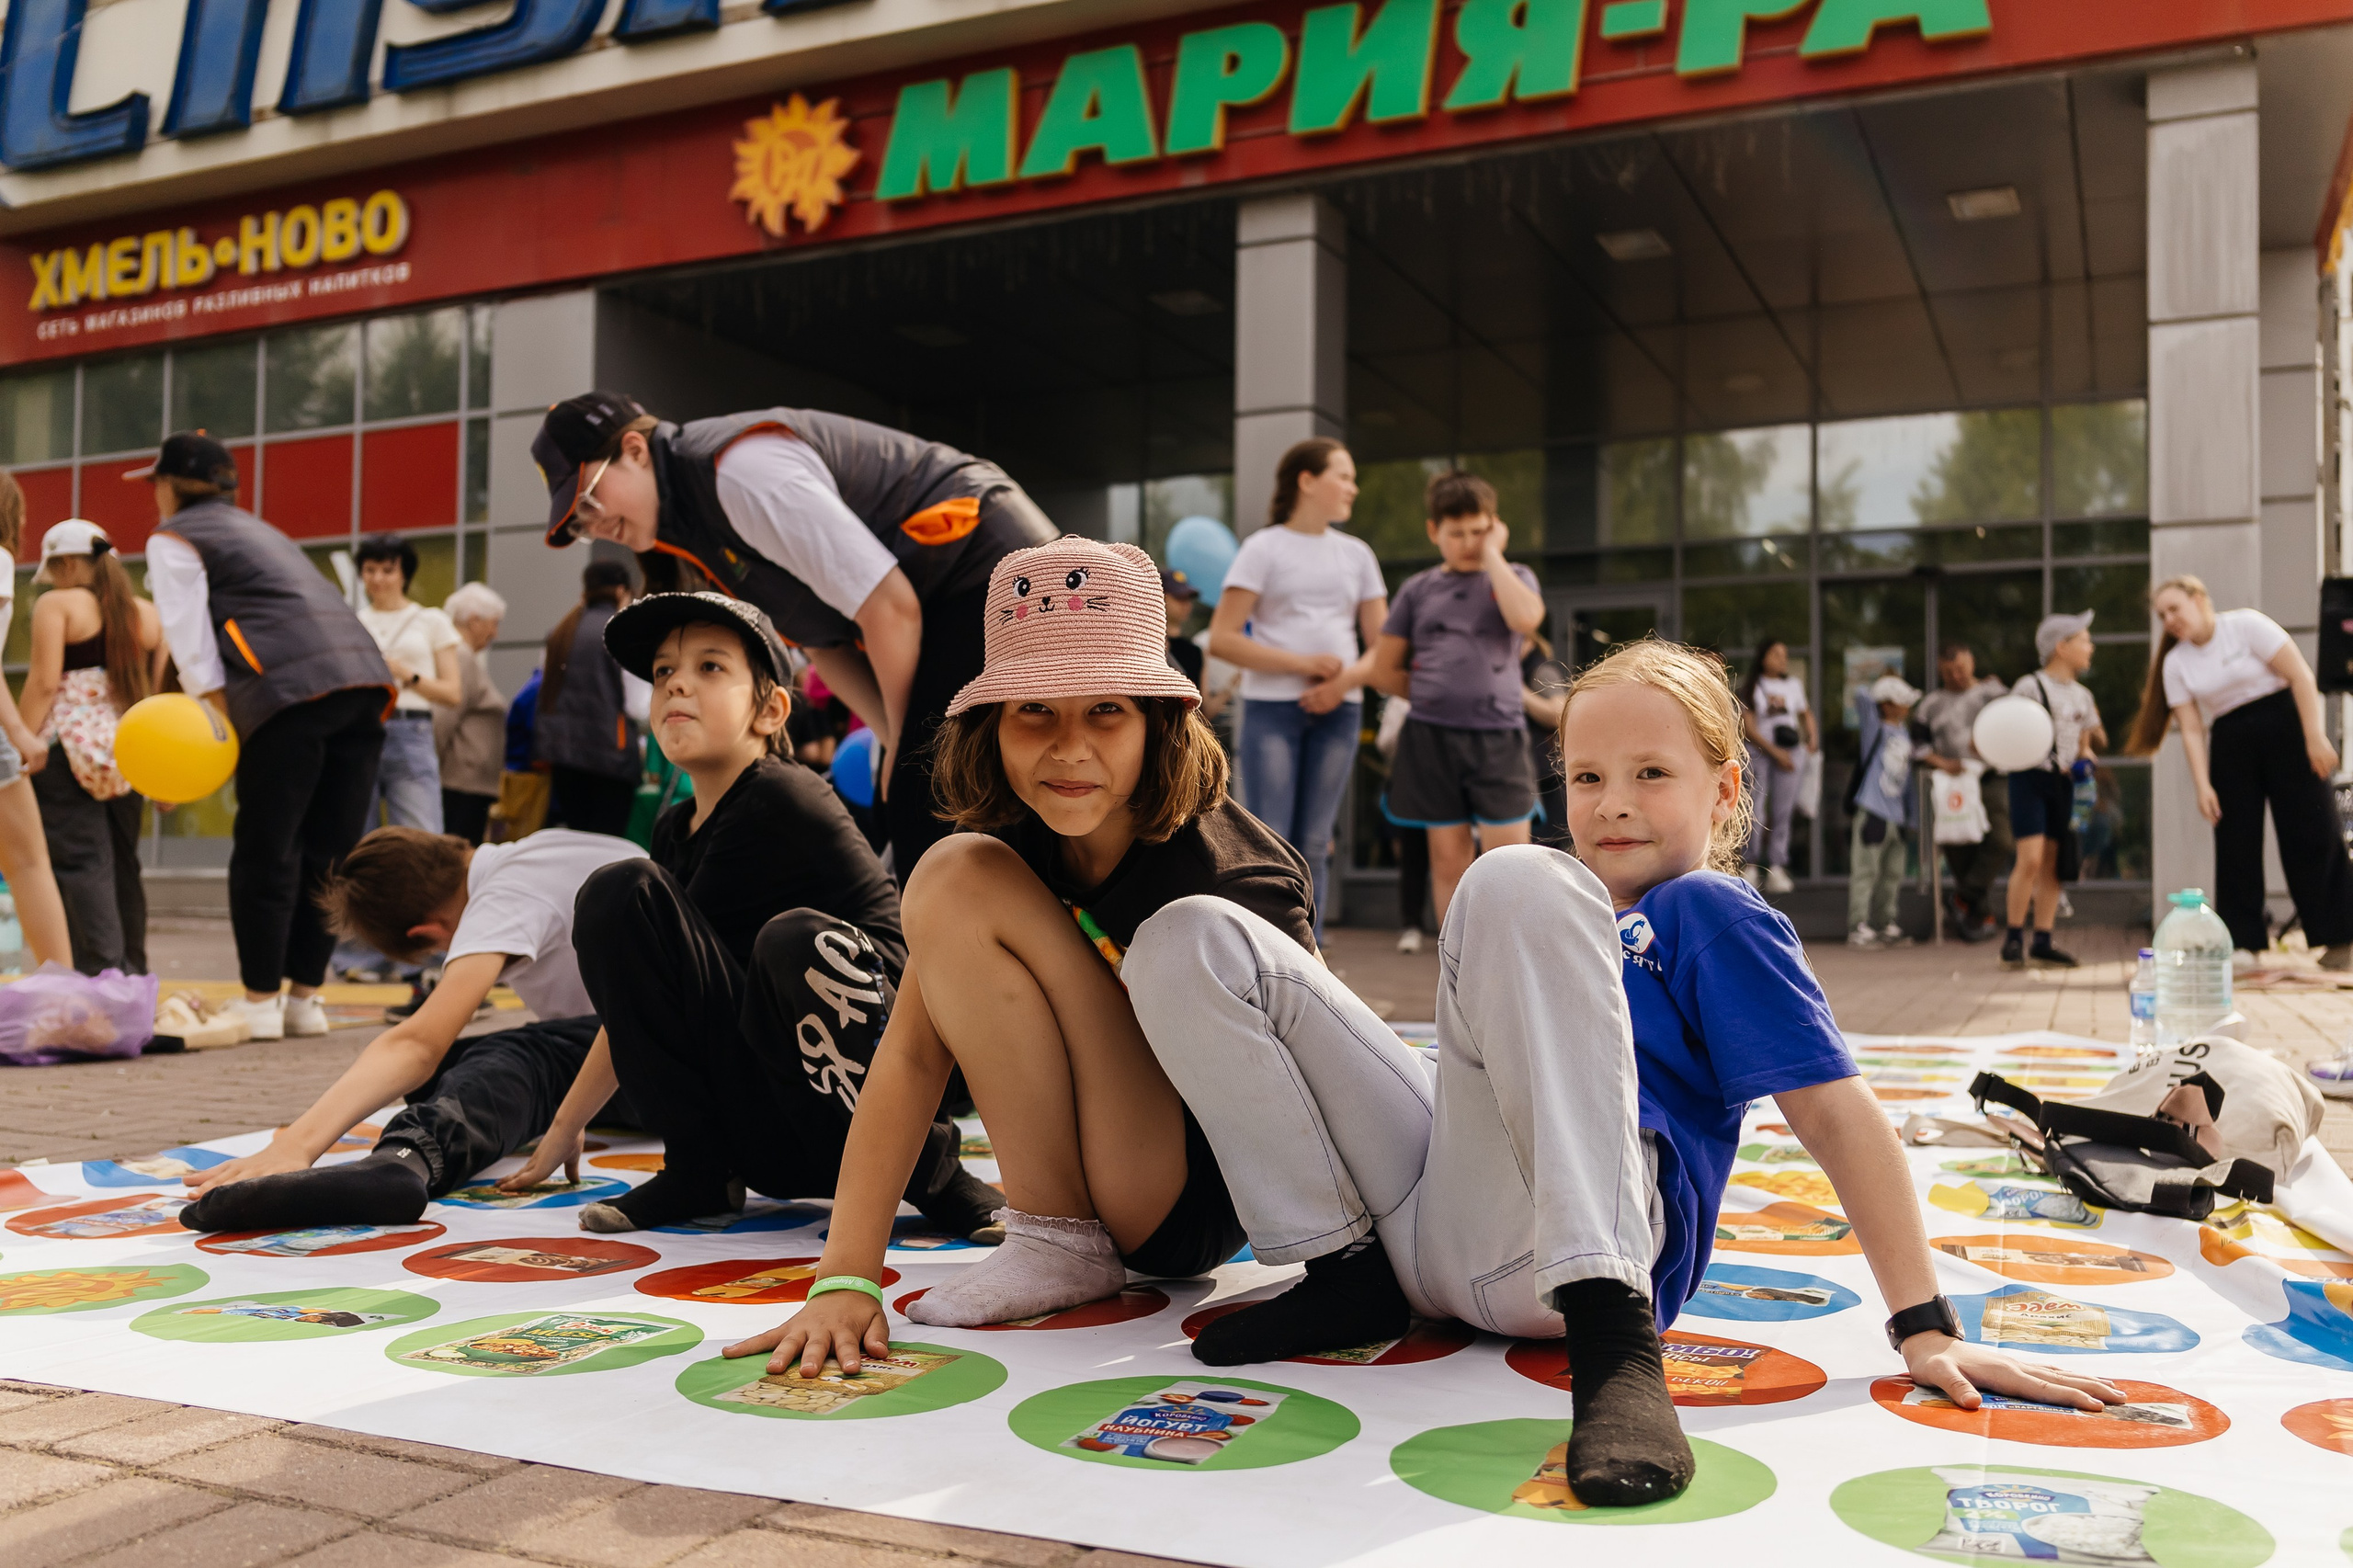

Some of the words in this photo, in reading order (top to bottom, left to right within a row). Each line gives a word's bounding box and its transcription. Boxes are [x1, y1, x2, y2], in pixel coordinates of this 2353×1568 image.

[37, 317, 80, 341] СЕТЬ
[84, 299, 188, 332] МАГАЗИНОВ
[192, 283, 304, 316] РАЗЛИВНЫХ
[308, 261, 412, 298] НАПИТКОВ
[2007, 1301, 2082, 1312] Эдем
[1120, 1415, 1209, 1433] ЙОГУРТ
[1154, 1412, 1208, 1423] КОРОВКИНО
[1103, 1424, 1185, 1437] КЛУБНИКА
[1957, 1497, 2061, 1513] ТВОРОГ
